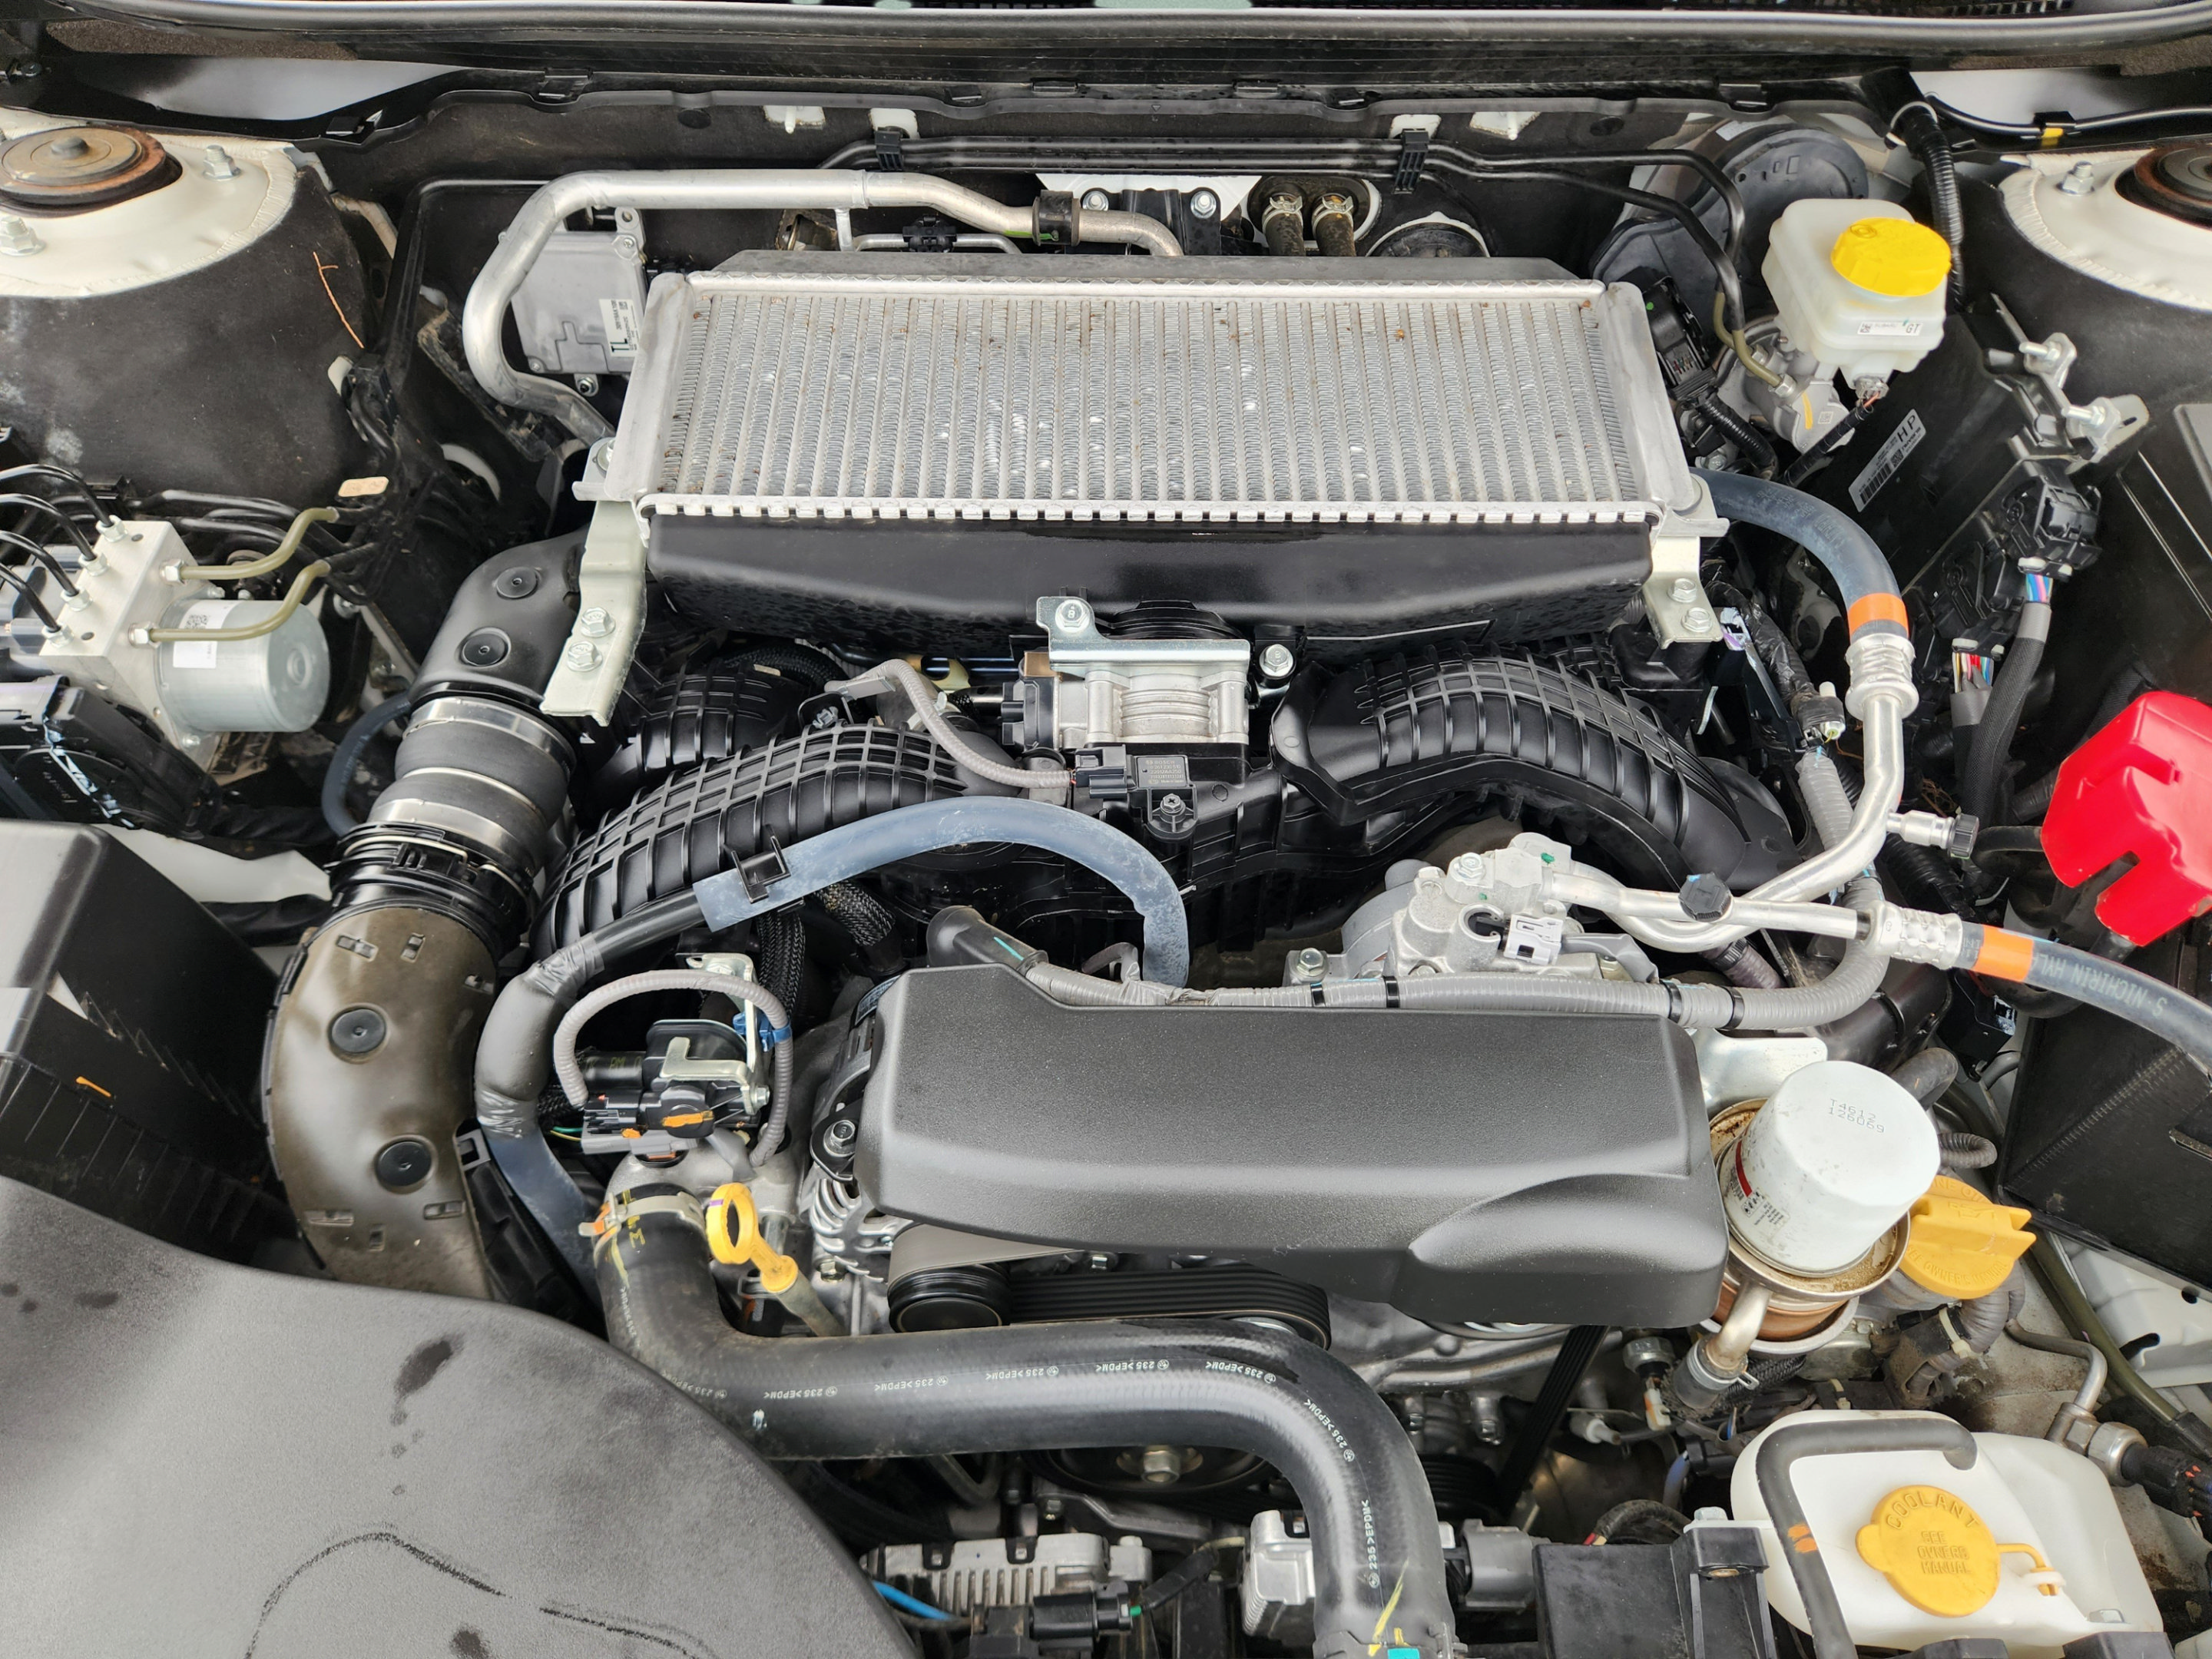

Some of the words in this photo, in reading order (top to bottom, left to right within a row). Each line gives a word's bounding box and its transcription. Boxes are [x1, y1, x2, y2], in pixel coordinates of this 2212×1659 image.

[1906, 323, 1921, 333] GT
[610, 339, 629, 352] TL
[2071, 965, 2150, 1008] NICHIRIN
[1830, 1098, 1876, 1121] T4612
[1828, 1107, 1885, 1133] 126069
[1136, 1361, 1154, 1370] 235
[1025, 1368, 1044, 1377] 235
[1245, 1367, 1263, 1379] 235
[915, 1378, 933, 1388] 235
[805, 1388, 823, 1398] 235
[1332, 1429, 1348, 1449] 235
[1886, 1491, 1979, 1529] COOLANT
[1921, 1531, 1947, 1544] SEE
[1367, 1546, 1378, 1570] 235
[1917, 1546, 1970, 1559] OWNERS
[1921, 1561, 1971, 1574] MANUAL
